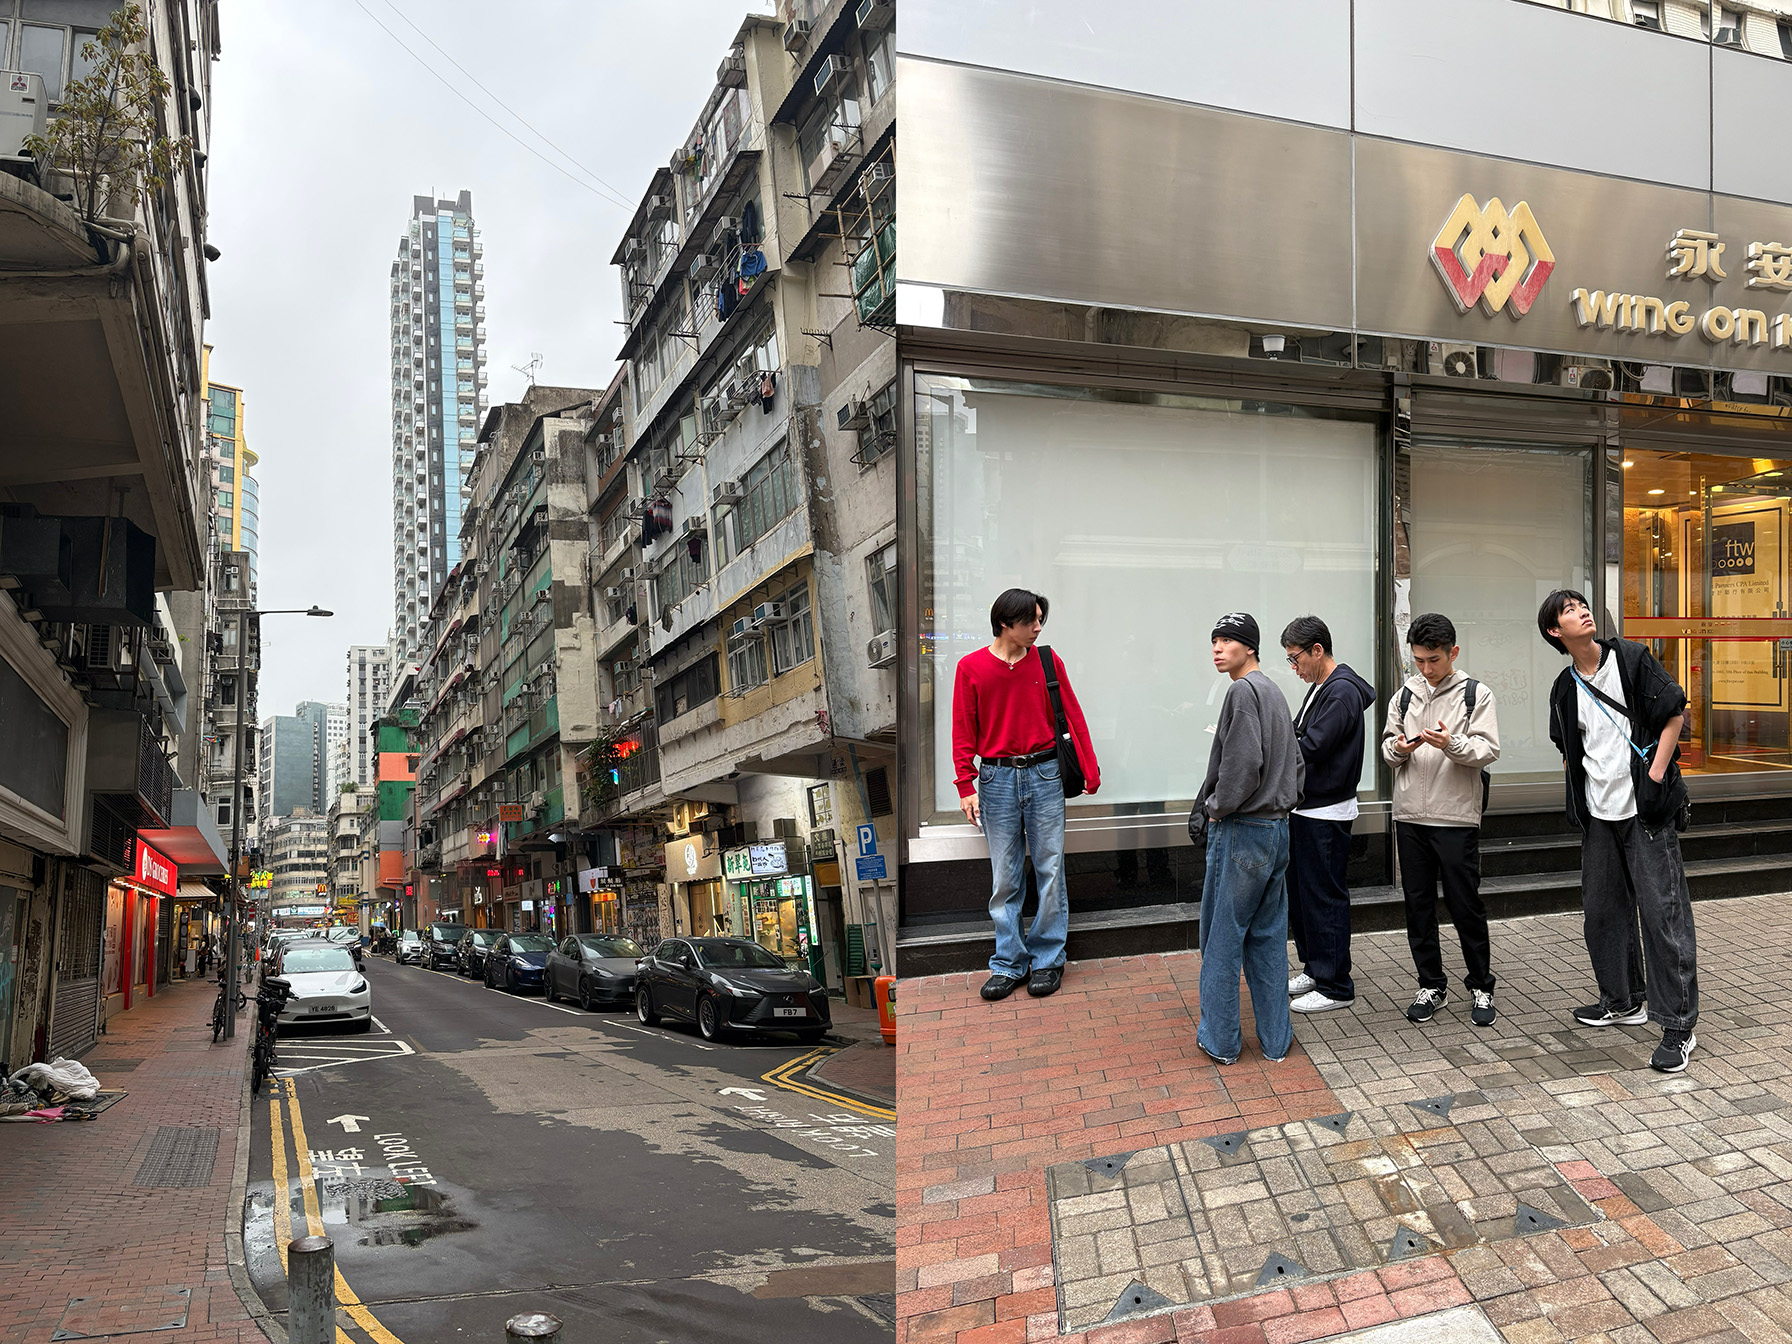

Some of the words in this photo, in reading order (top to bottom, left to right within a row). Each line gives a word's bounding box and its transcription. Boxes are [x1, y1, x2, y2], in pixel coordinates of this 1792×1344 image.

[1669, 228, 1792, 291] 永安
[1725, 539, 1754, 557] ftw
[1736, 580, 1748, 588] CPA
[859, 827, 873, 854] P
[373, 1133, 418, 1160] LOOK
[387, 1160, 438, 1186] LEFT
